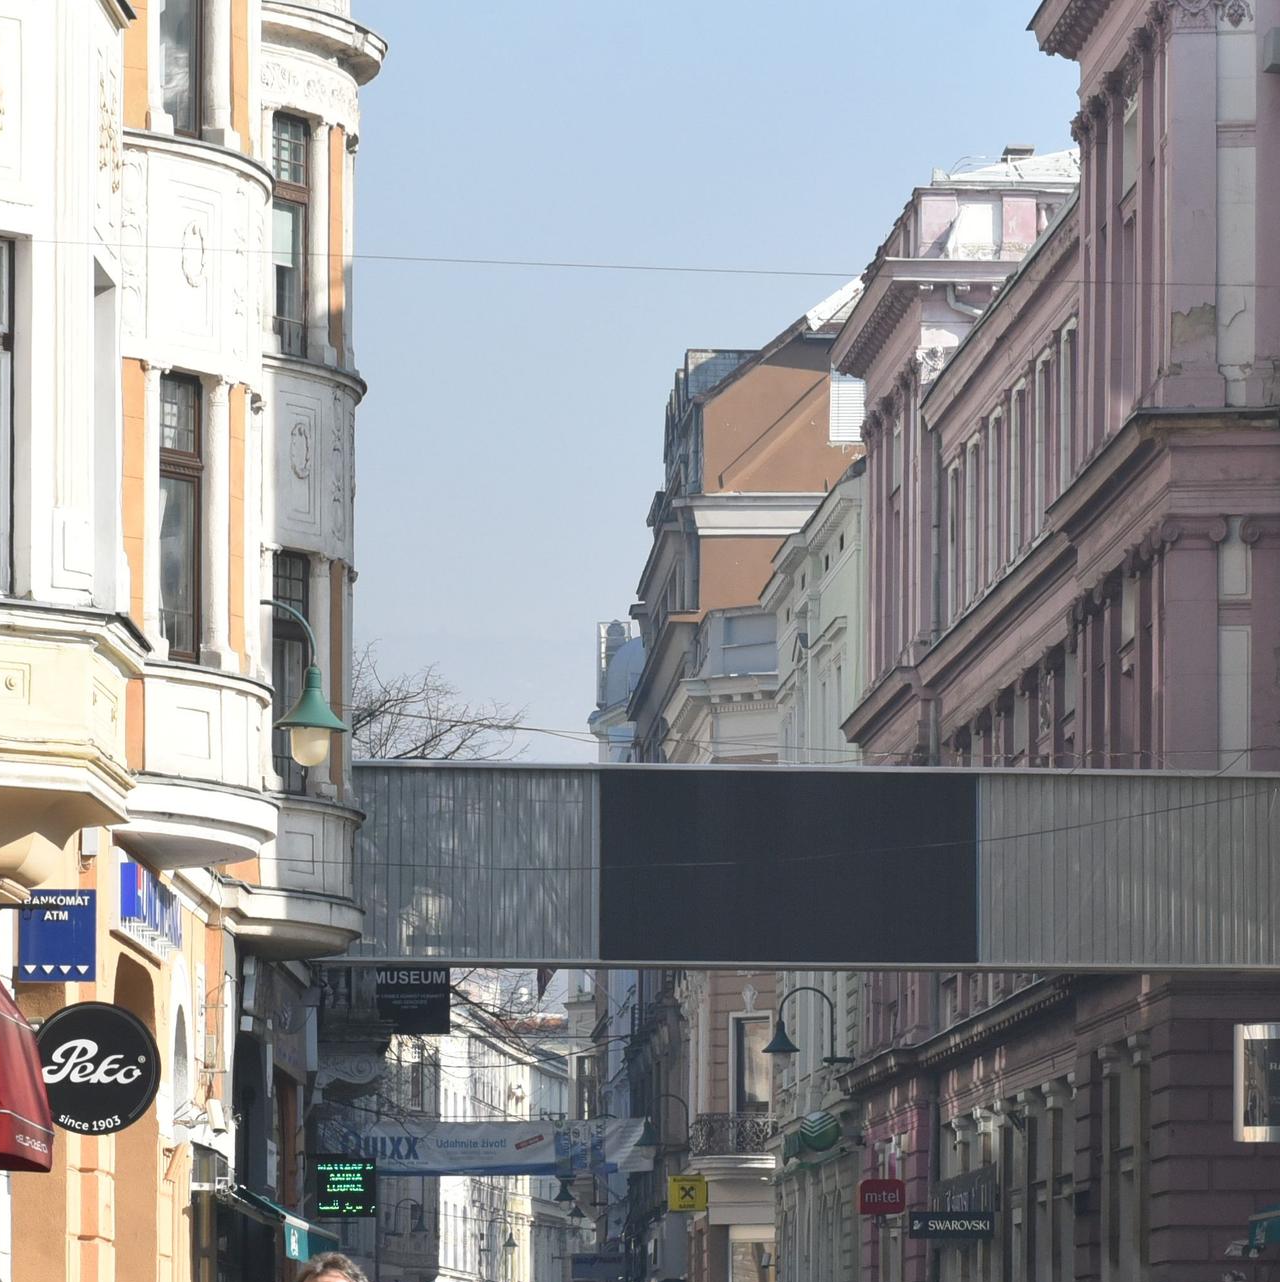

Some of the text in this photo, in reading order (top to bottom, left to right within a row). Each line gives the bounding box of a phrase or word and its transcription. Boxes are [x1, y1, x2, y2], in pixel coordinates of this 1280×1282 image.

[23, 895, 90, 906] BANKOMAT
[44, 911, 68, 921] ATM
[375, 970, 446, 985] MUSEUM
[59, 1113, 121, 1131] since 1903
[864, 1189, 901, 1204] m:tel
[927, 1219, 990, 1231] SWAROVSKI
